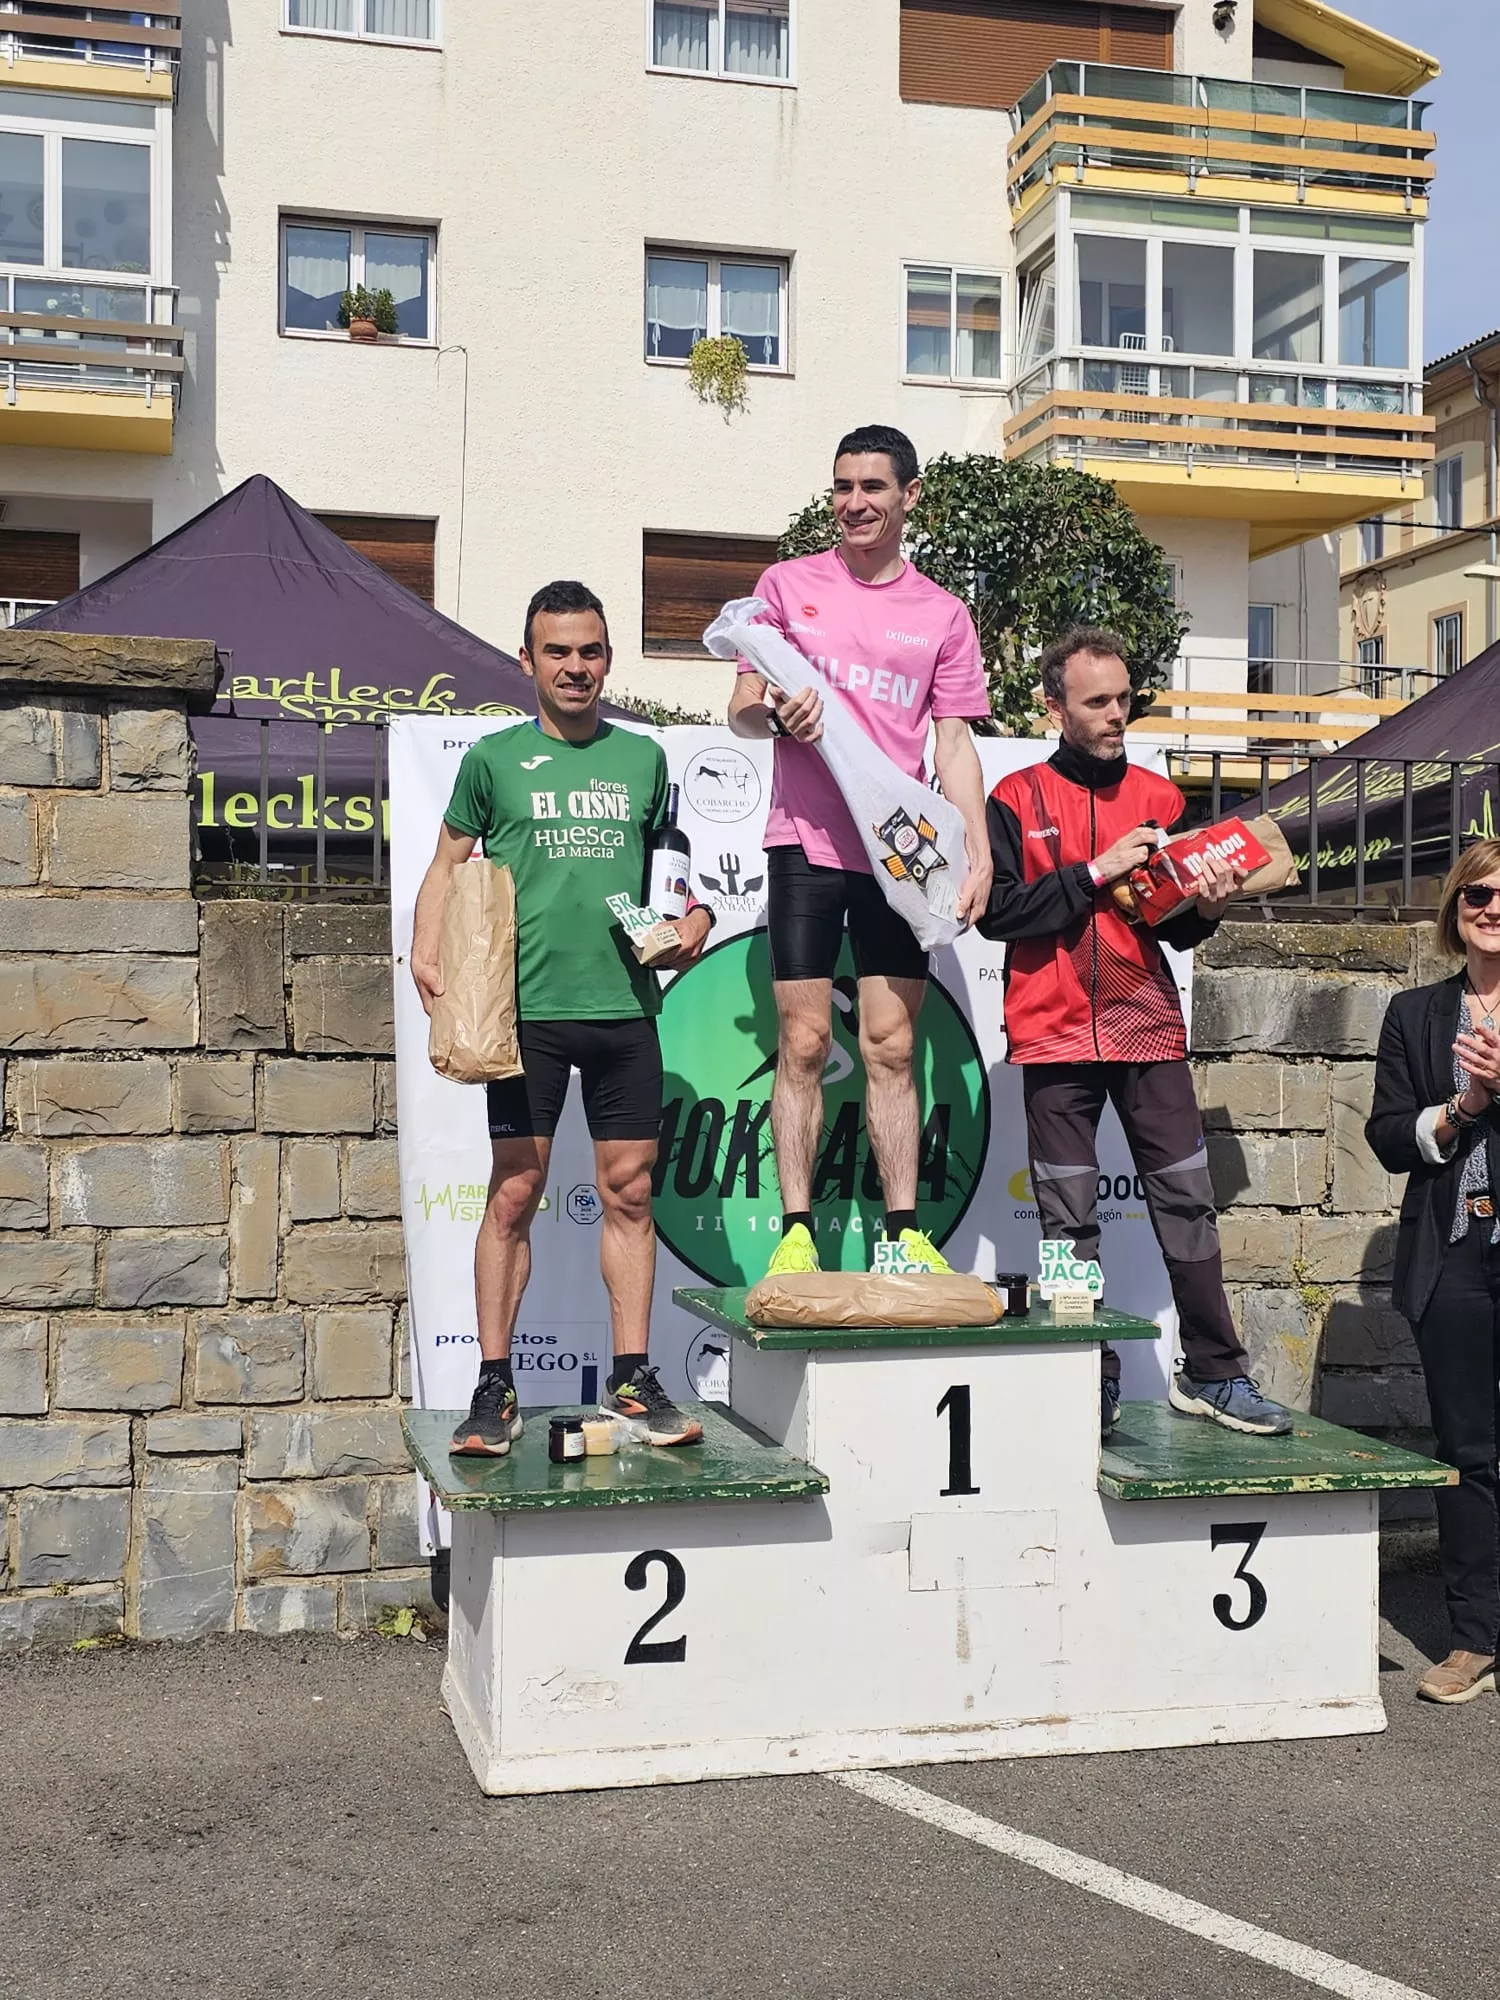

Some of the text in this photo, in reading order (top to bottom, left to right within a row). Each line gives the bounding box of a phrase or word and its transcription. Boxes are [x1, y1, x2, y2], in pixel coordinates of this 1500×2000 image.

[231, 667, 456, 713] artleck
[808, 655, 919, 709] ILPEN
[590, 778, 628, 793] flores
[188, 771, 390, 840] lecks
[531, 790, 630, 822] EL CISNE
[608, 894, 637, 915] 5K
[621, 907, 664, 932] JACA
[651, 1097, 771, 1199] 10K
[457, 1184, 487, 1199] FAR
[574, 1194, 596, 1207] RSA
[695, 1216, 723, 1231] II
[747, 1215, 780, 1232] 10
[1014, 1208, 1122, 1222] cone agón
[877, 1243, 908, 1263] 5K
[1041, 1242, 1074, 1261] 5K
[1041, 1262, 1102, 1281] JACA
[435, 1330, 558, 1347] proctos
[936, 1384, 981, 1497] 1
[1210, 1521, 1268, 1631] 3
[623, 1549, 687, 1665] 2
